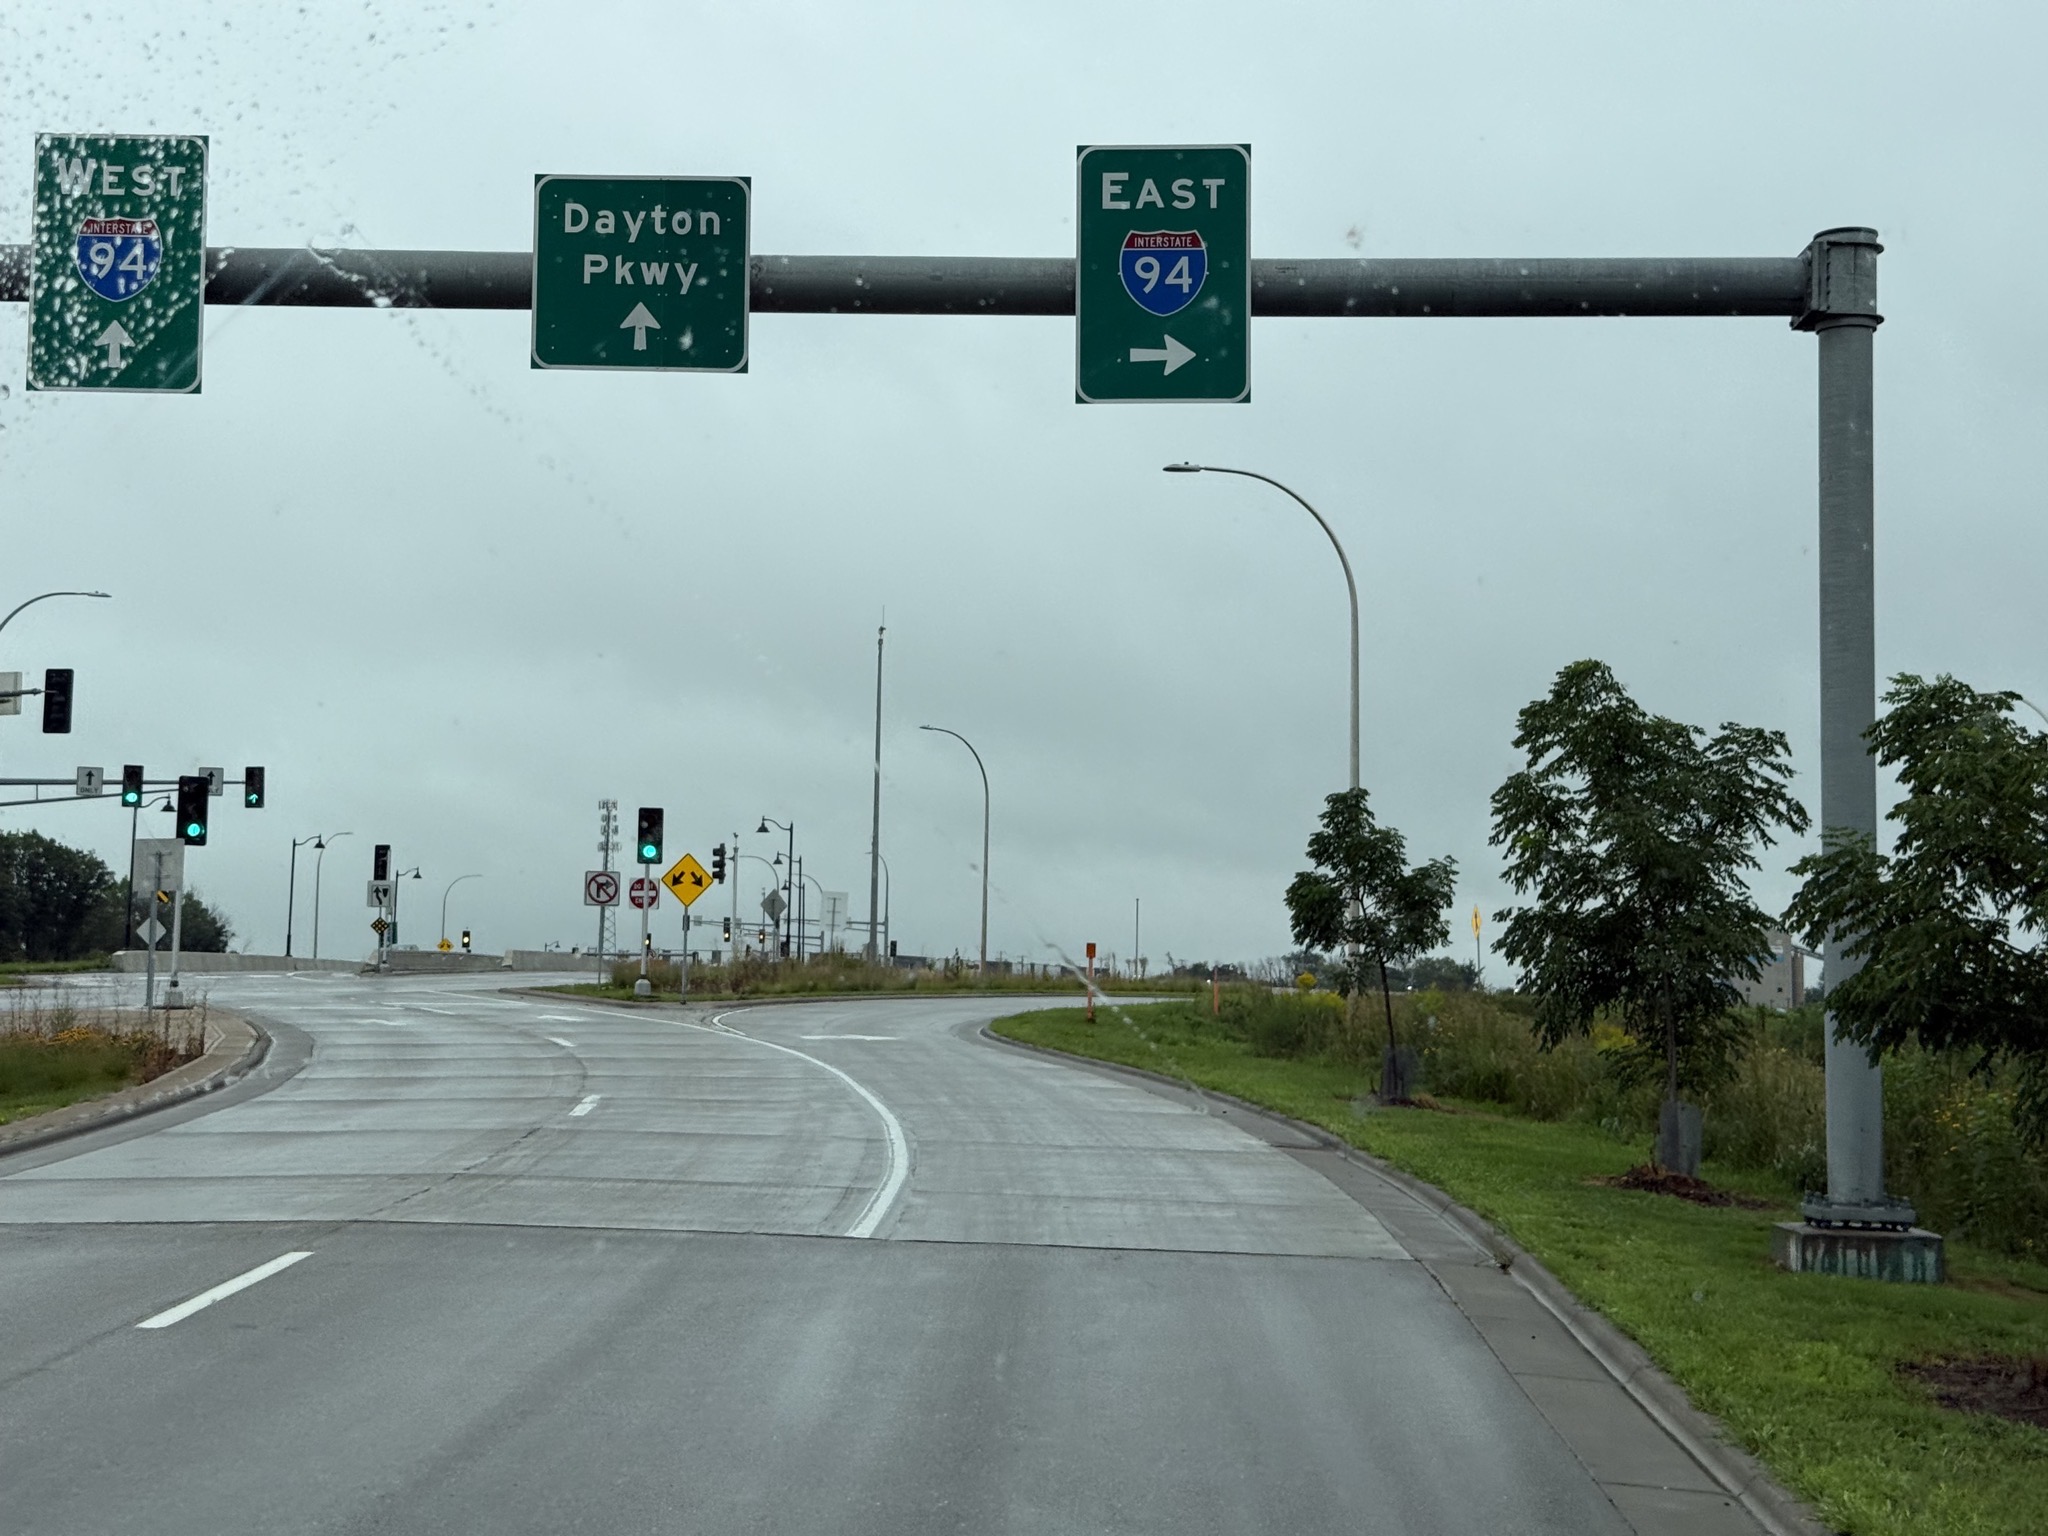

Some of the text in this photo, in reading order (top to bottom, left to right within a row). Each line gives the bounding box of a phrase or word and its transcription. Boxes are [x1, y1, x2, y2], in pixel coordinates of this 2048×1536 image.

[58, 157, 187, 197] WEST
[1102, 172, 1226, 210] EAST
[564, 202, 721, 244] Dayton
[1134, 235, 1193, 248] INTERSTATE
[89, 242, 147, 281] 94
[583, 253, 699, 295] Pkwy
[1134, 255, 1193, 294] 94
